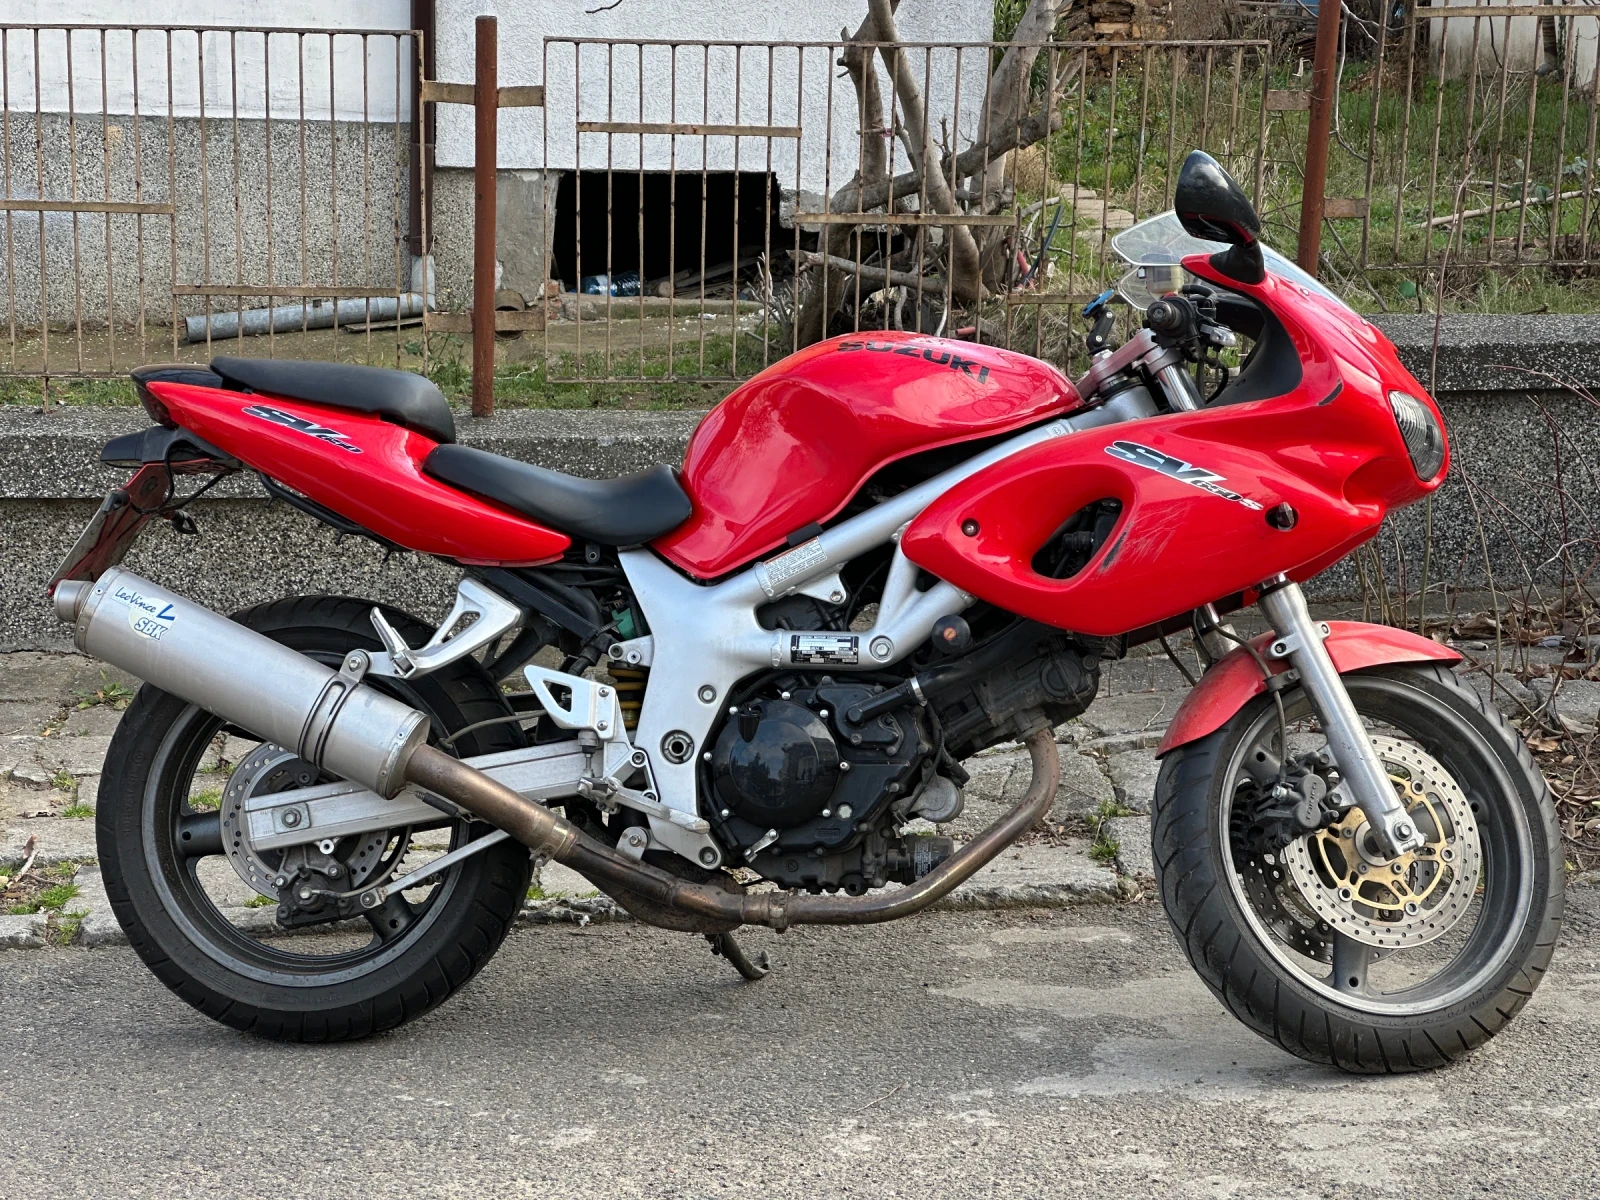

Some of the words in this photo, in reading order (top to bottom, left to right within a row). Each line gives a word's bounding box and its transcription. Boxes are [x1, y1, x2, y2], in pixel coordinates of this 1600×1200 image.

[837, 340, 991, 385] SUZUKI
[241, 405, 352, 438] SV
[1104, 440, 1228, 484] SV
[115, 586, 157, 613] LeoVince
[134, 616, 169, 641] SBK
